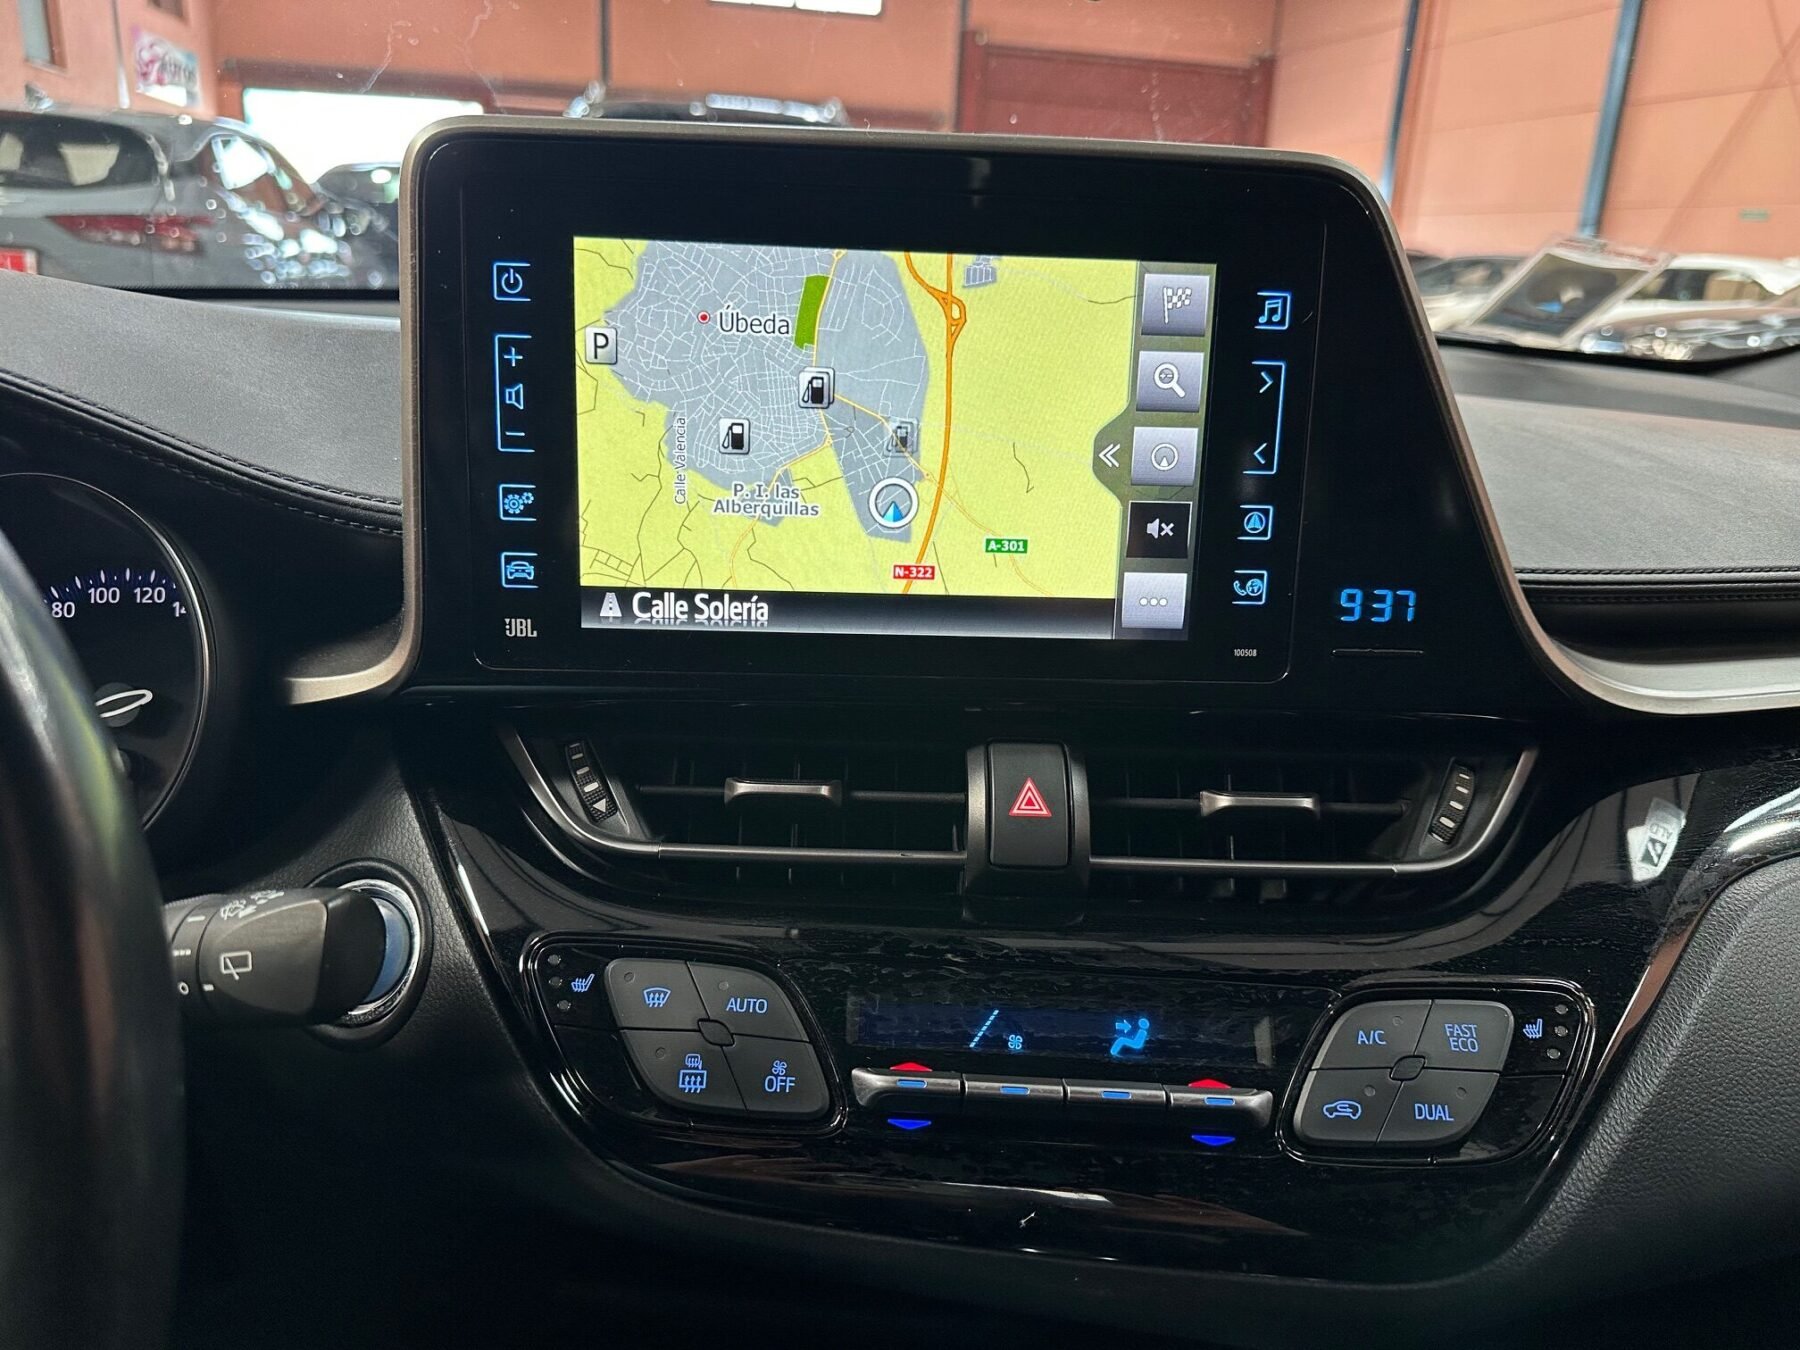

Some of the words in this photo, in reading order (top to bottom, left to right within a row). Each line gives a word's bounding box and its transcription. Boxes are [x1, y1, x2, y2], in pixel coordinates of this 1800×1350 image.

[719, 305, 790, 335] Úbeda
[674, 417, 686, 471] Valencia
[674, 473, 687, 505] Calle
[732, 484, 750, 498] P.
[774, 484, 800, 499] las
[713, 500, 820, 517] Alberquillas
[988, 539, 1025, 552] A-301
[895, 565, 933, 579] N-322
[88, 587, 120, 604] 100
[134, 587, 166, 604] 120
[51, 602, 76, 618] 80
[632, 592, 689, 619] Calle
[693, 594, 769, 621] Solería
[505, 618, 537, 638] JBL
[1233, 648, 1257, 657] 100508
[726, 998, 768, 1014] AUTO
[1357, 1030, 1387, 1045] A/C
[1444, 1024, 1477, 1038] FAST
[1450, 1038, 1478, 1052] ECO
[764, 1076, 796, 1093] OFF
[1414, 1103, 1454, 1121] DUAL
